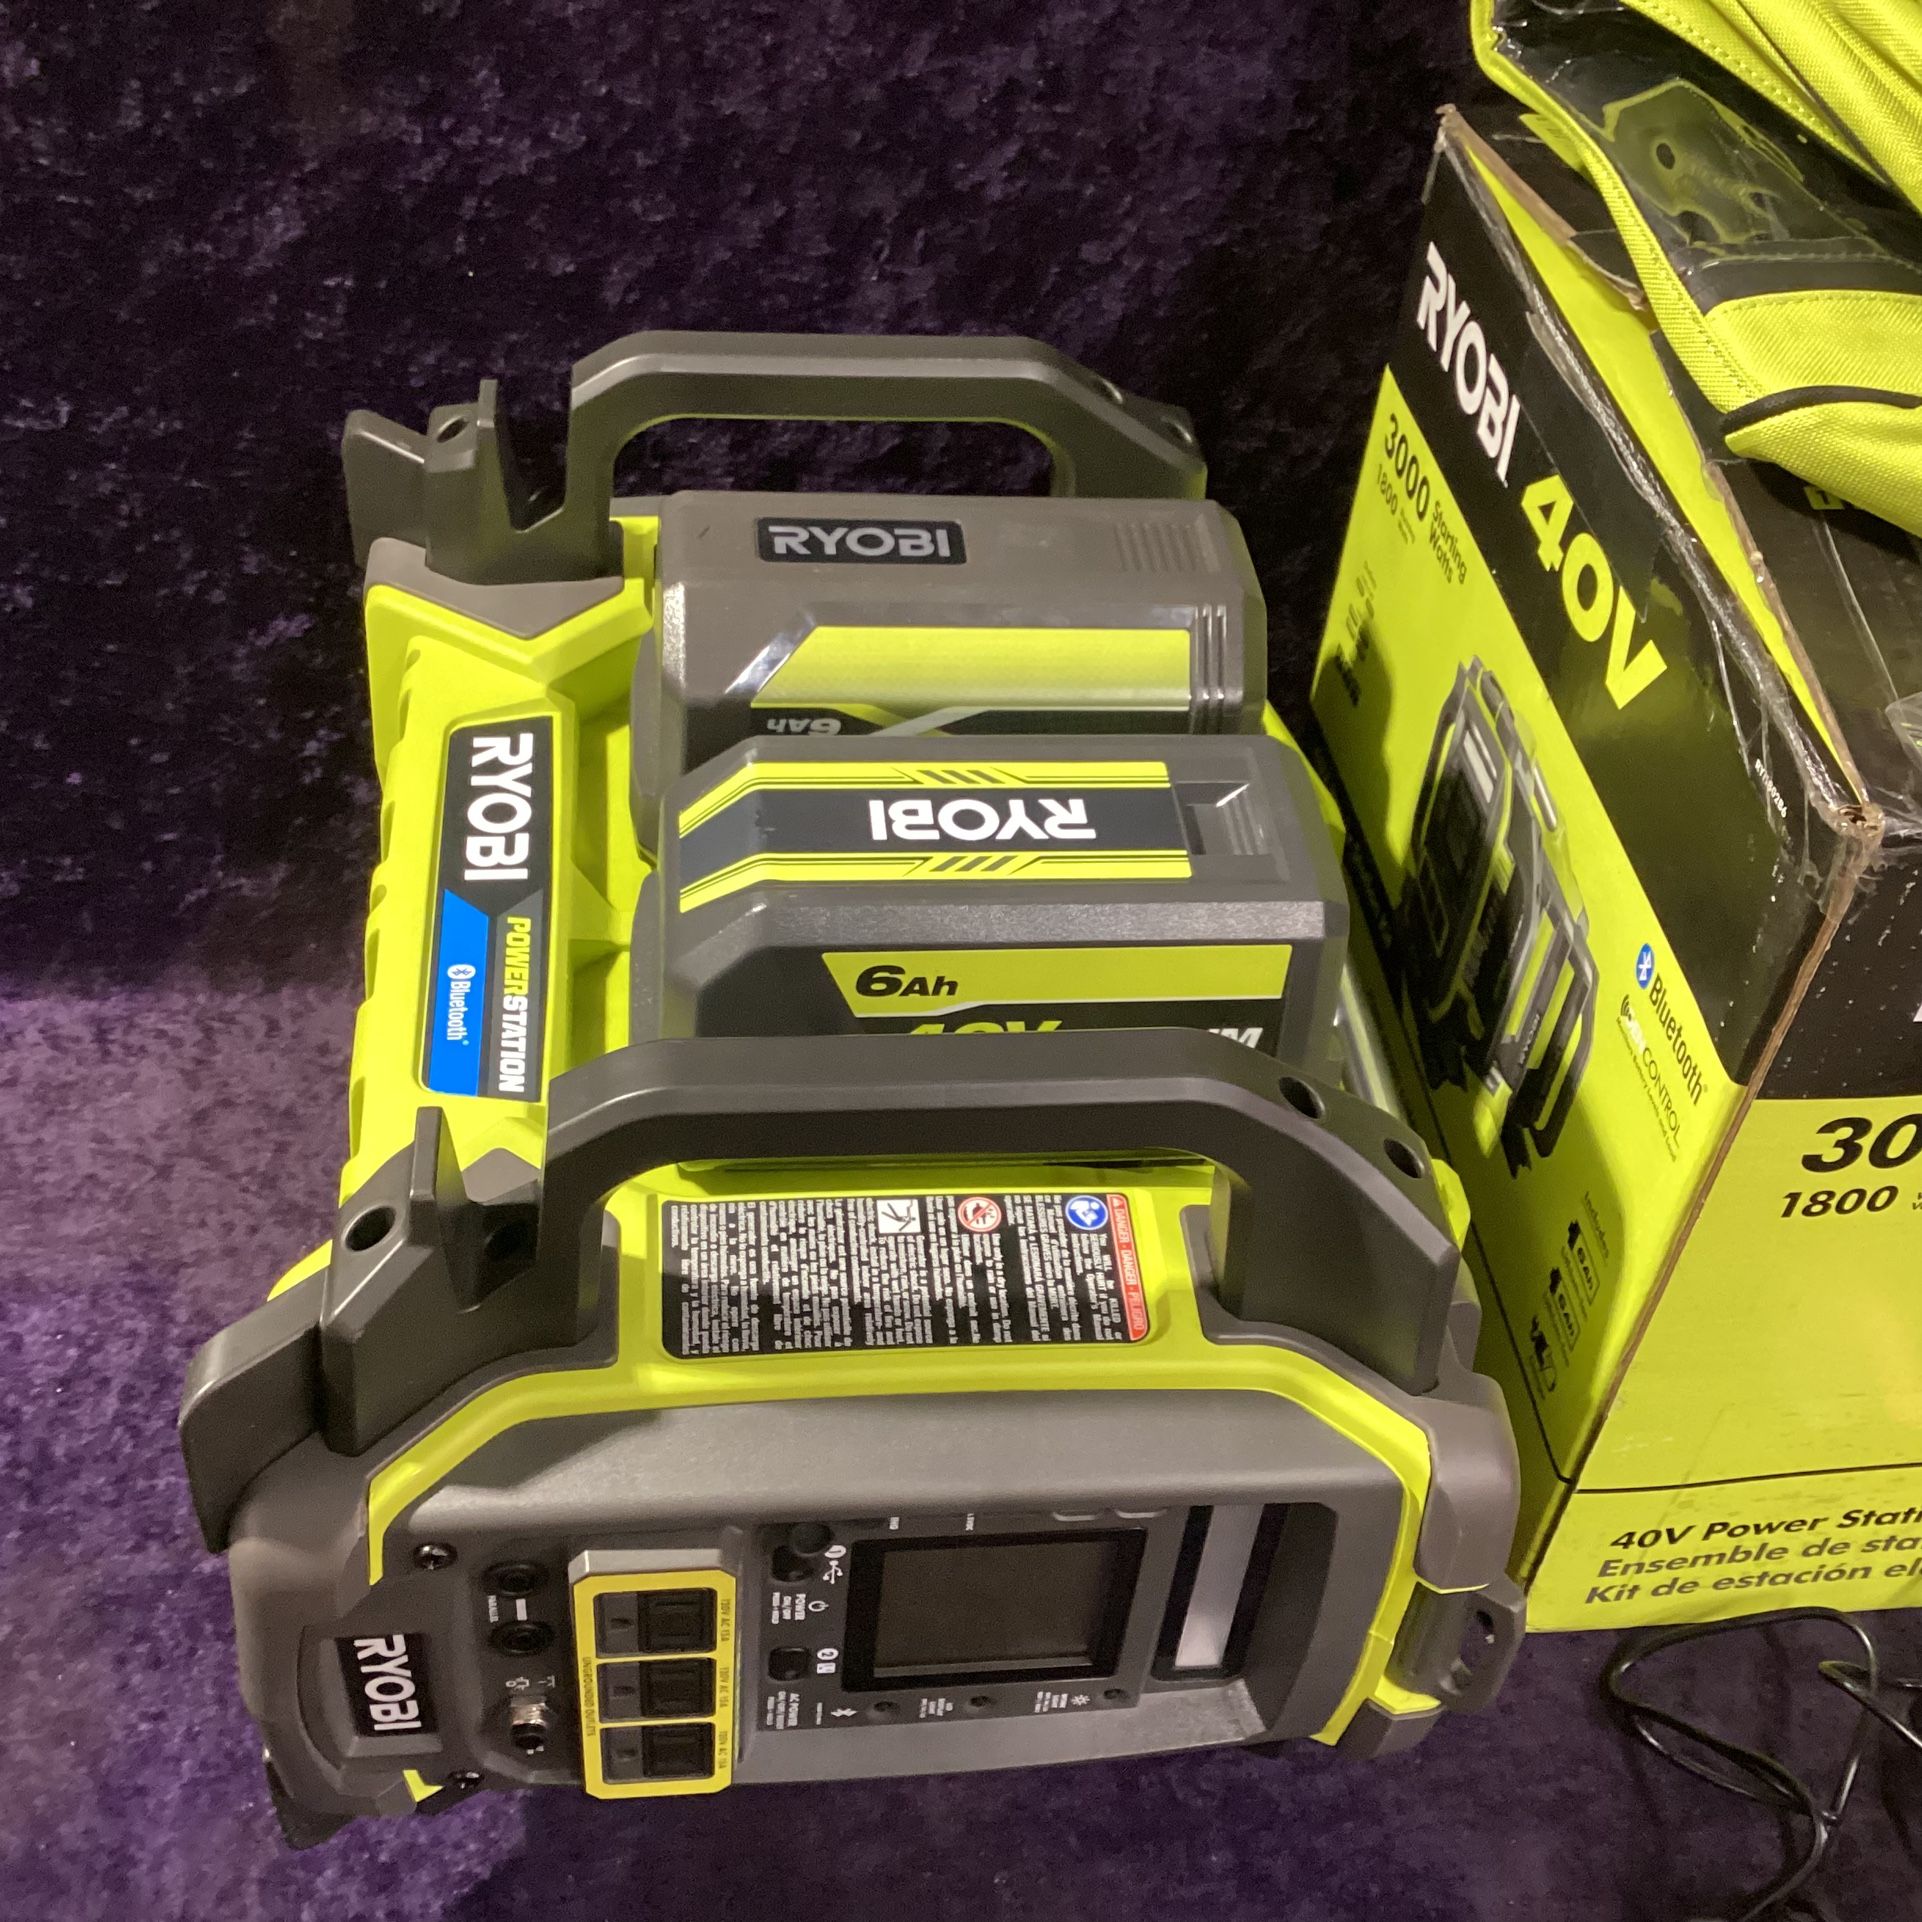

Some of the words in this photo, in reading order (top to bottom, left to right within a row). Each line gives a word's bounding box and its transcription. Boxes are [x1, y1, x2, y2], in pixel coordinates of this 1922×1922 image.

[1375, 462, 1399, 517] 1800
[1383, 412, 1432, 523] 3000
[1416, 241, 1520, 482] RYOBI
[1521, 474, 1667, 709] 40V
[768, 525, 951, 558] RYOBI
[1428, 525, 1455, 585] Watts
[1431, 498, 1468, 586] Starting
[766, 718, 842, 736] 6Ah
[464, 731, 535, 882] RYOBI
[869, 799, 1097, 841] RYOBI
[855, 964, 959, 999] 6Ah
[446, 980, 472, 1041] Bluetooth
[497, 916, 533, 1093] POWERSTATION
[1650, 973, 1704, 1107] Bluetooth
[1781, 1185, 1899, 1218] 1800
[1113, 1208, 1129, 1242] DANGER
[1120, 1249, 1137, 1284] DANGER
[1609, 1523, 1697, 1551] 40V
[1702, 1515, 1831, 1542] Power
[1596, 1541, 1789, 1578] Ensemble
[1800, 1537, 1852, 1558] de
[1585, 1584, 1642, 1605] Kit
[1650, 1576, 1705, 1599] de
[1711, 1561, 1873, 1591] estación
[1883, 1556, 1922, 1579] el
[794, 1593, 806, 1620] POWER
[353, 1634, 422, 1731] RYOBI
[787, 1702, 799, 1727] POWER
